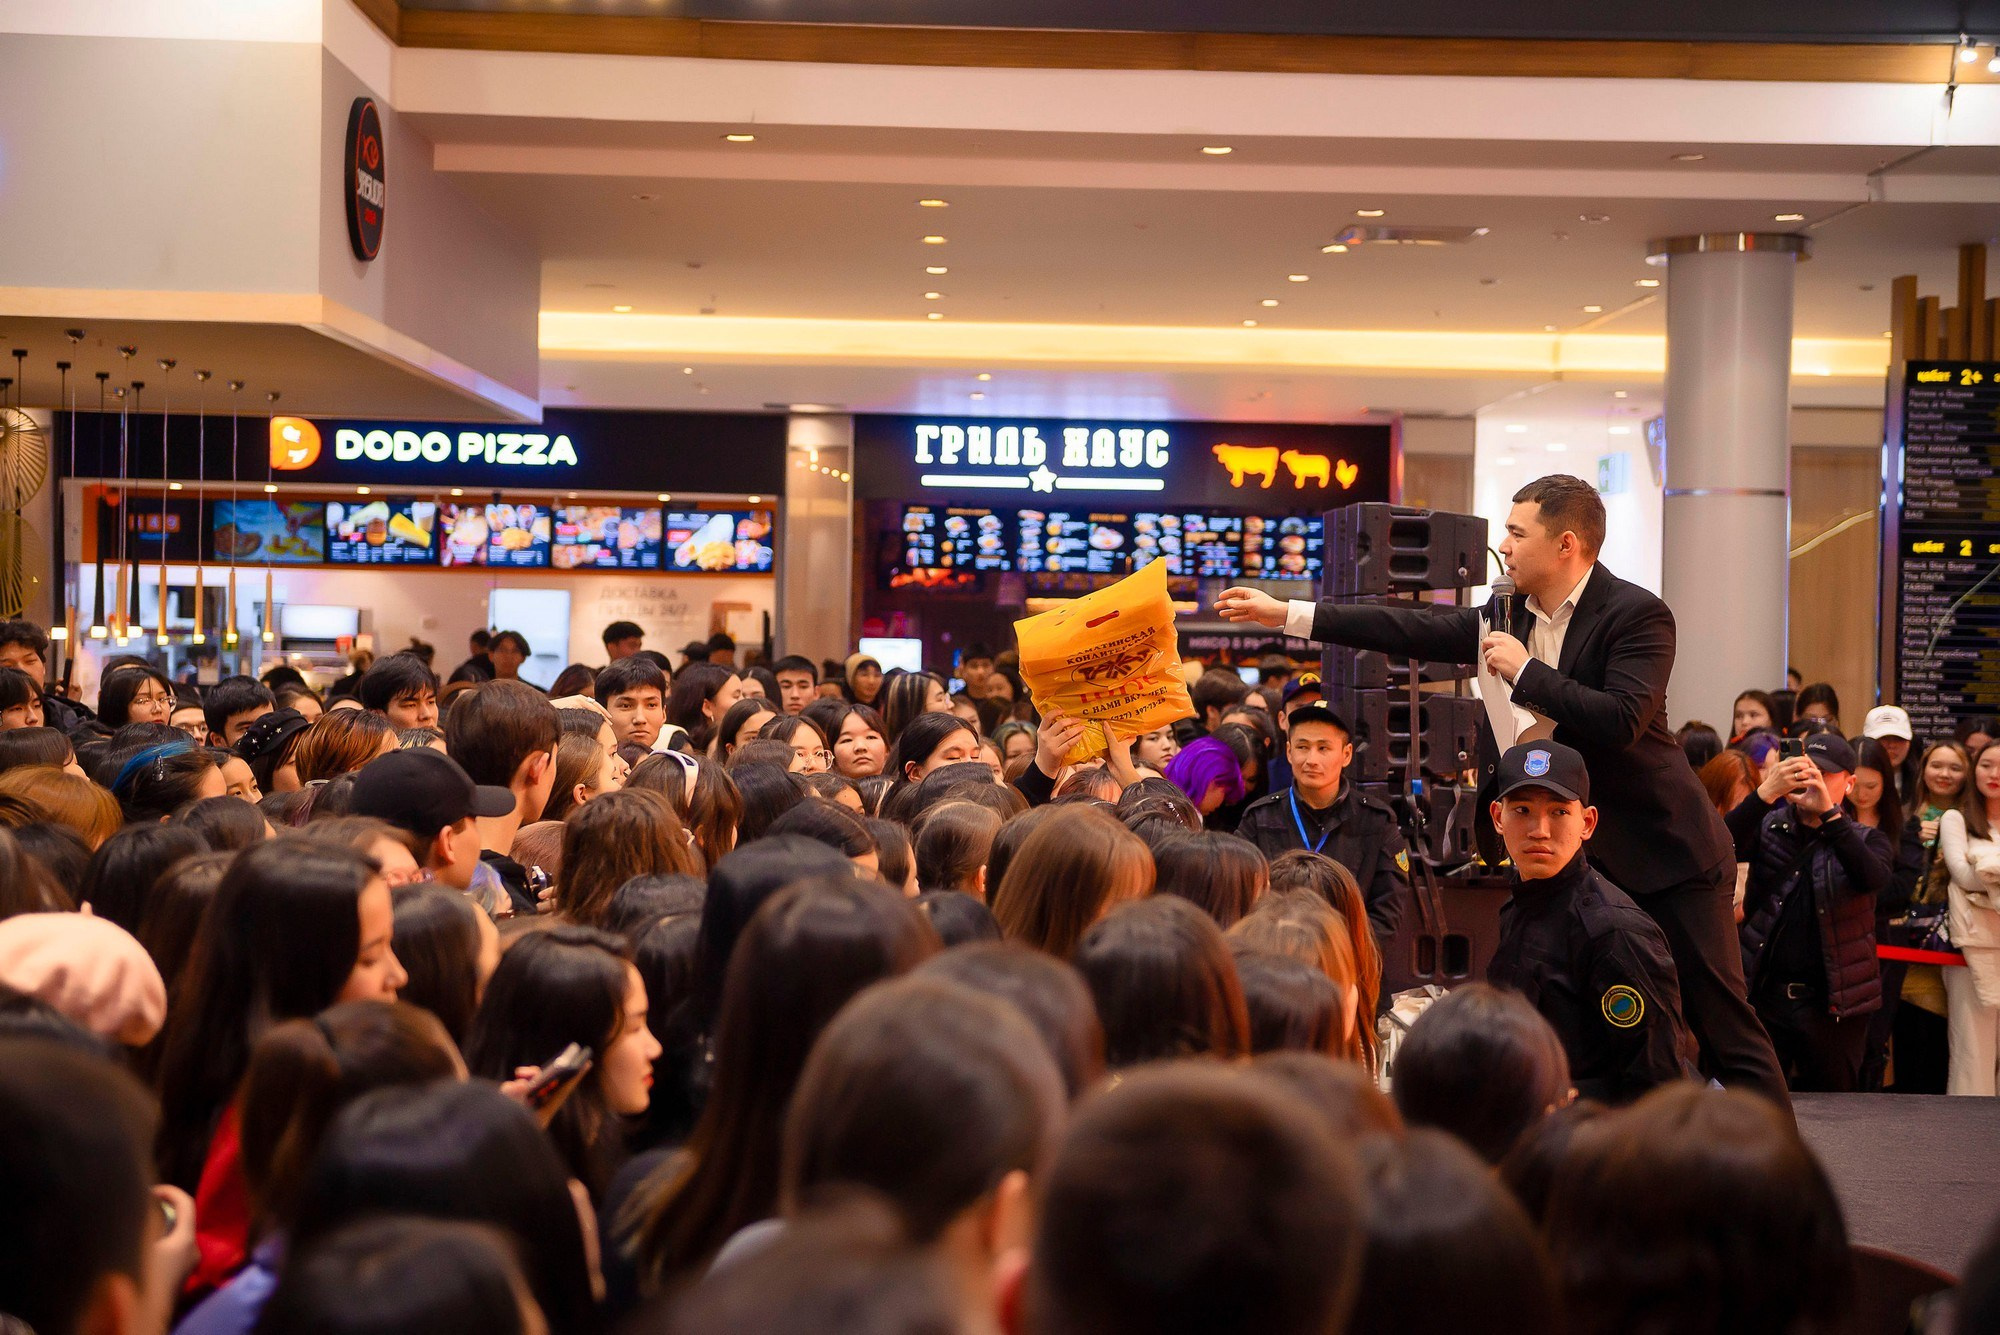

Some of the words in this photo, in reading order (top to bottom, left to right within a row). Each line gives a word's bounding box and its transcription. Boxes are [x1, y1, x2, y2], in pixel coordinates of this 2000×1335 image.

[1960, 368, 1983, 385] 2+
[335, 428, 452, 463] DODO
[458, 431, 578, 466] PIZZA
[914, 424, 1047, 466] ГРИЛЬ
[1062, 427, 1170, 469] ХАУС
[1960, 540, 1973, 556] 2
